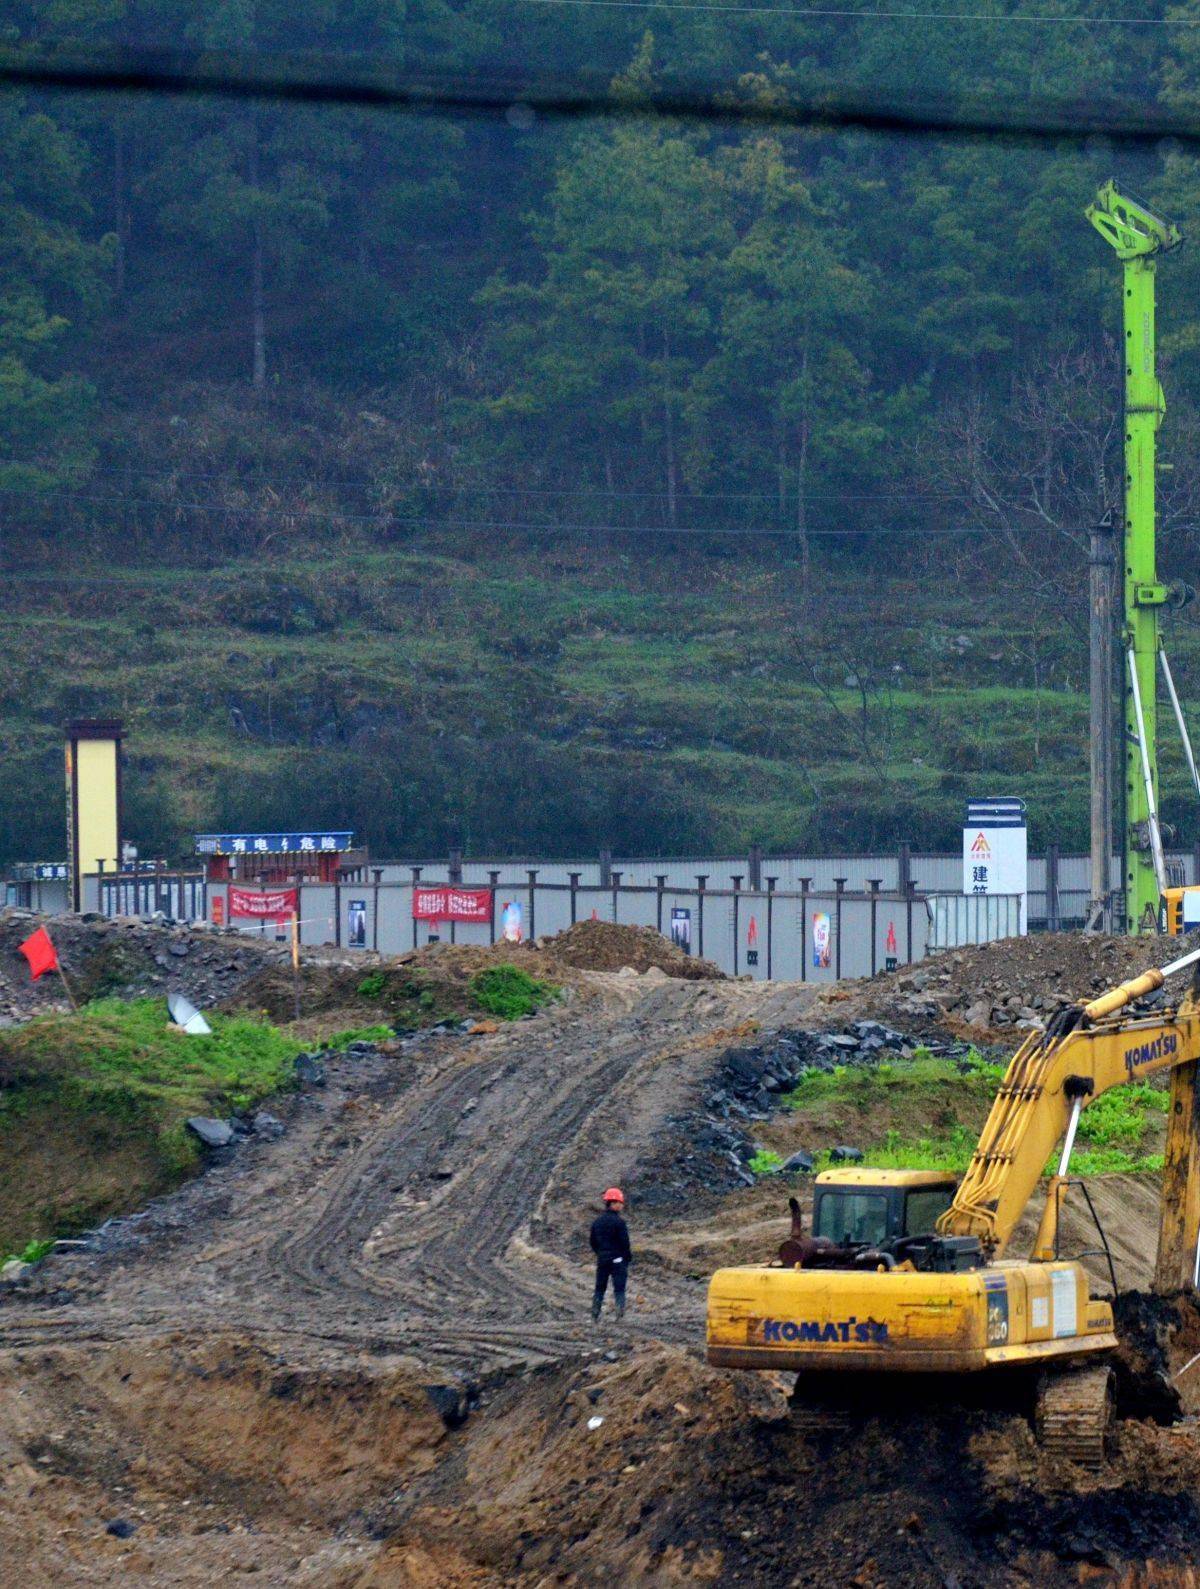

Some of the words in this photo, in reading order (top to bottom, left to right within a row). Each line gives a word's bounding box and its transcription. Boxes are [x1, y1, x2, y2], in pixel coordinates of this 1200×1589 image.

[232, 837, 268, 851] 有电
[300, 836, 337, 850] 危险
[1125, 1032, 1177, 1070] KOMATSU
[763, 1316, 888, 1342] KOMATSU
